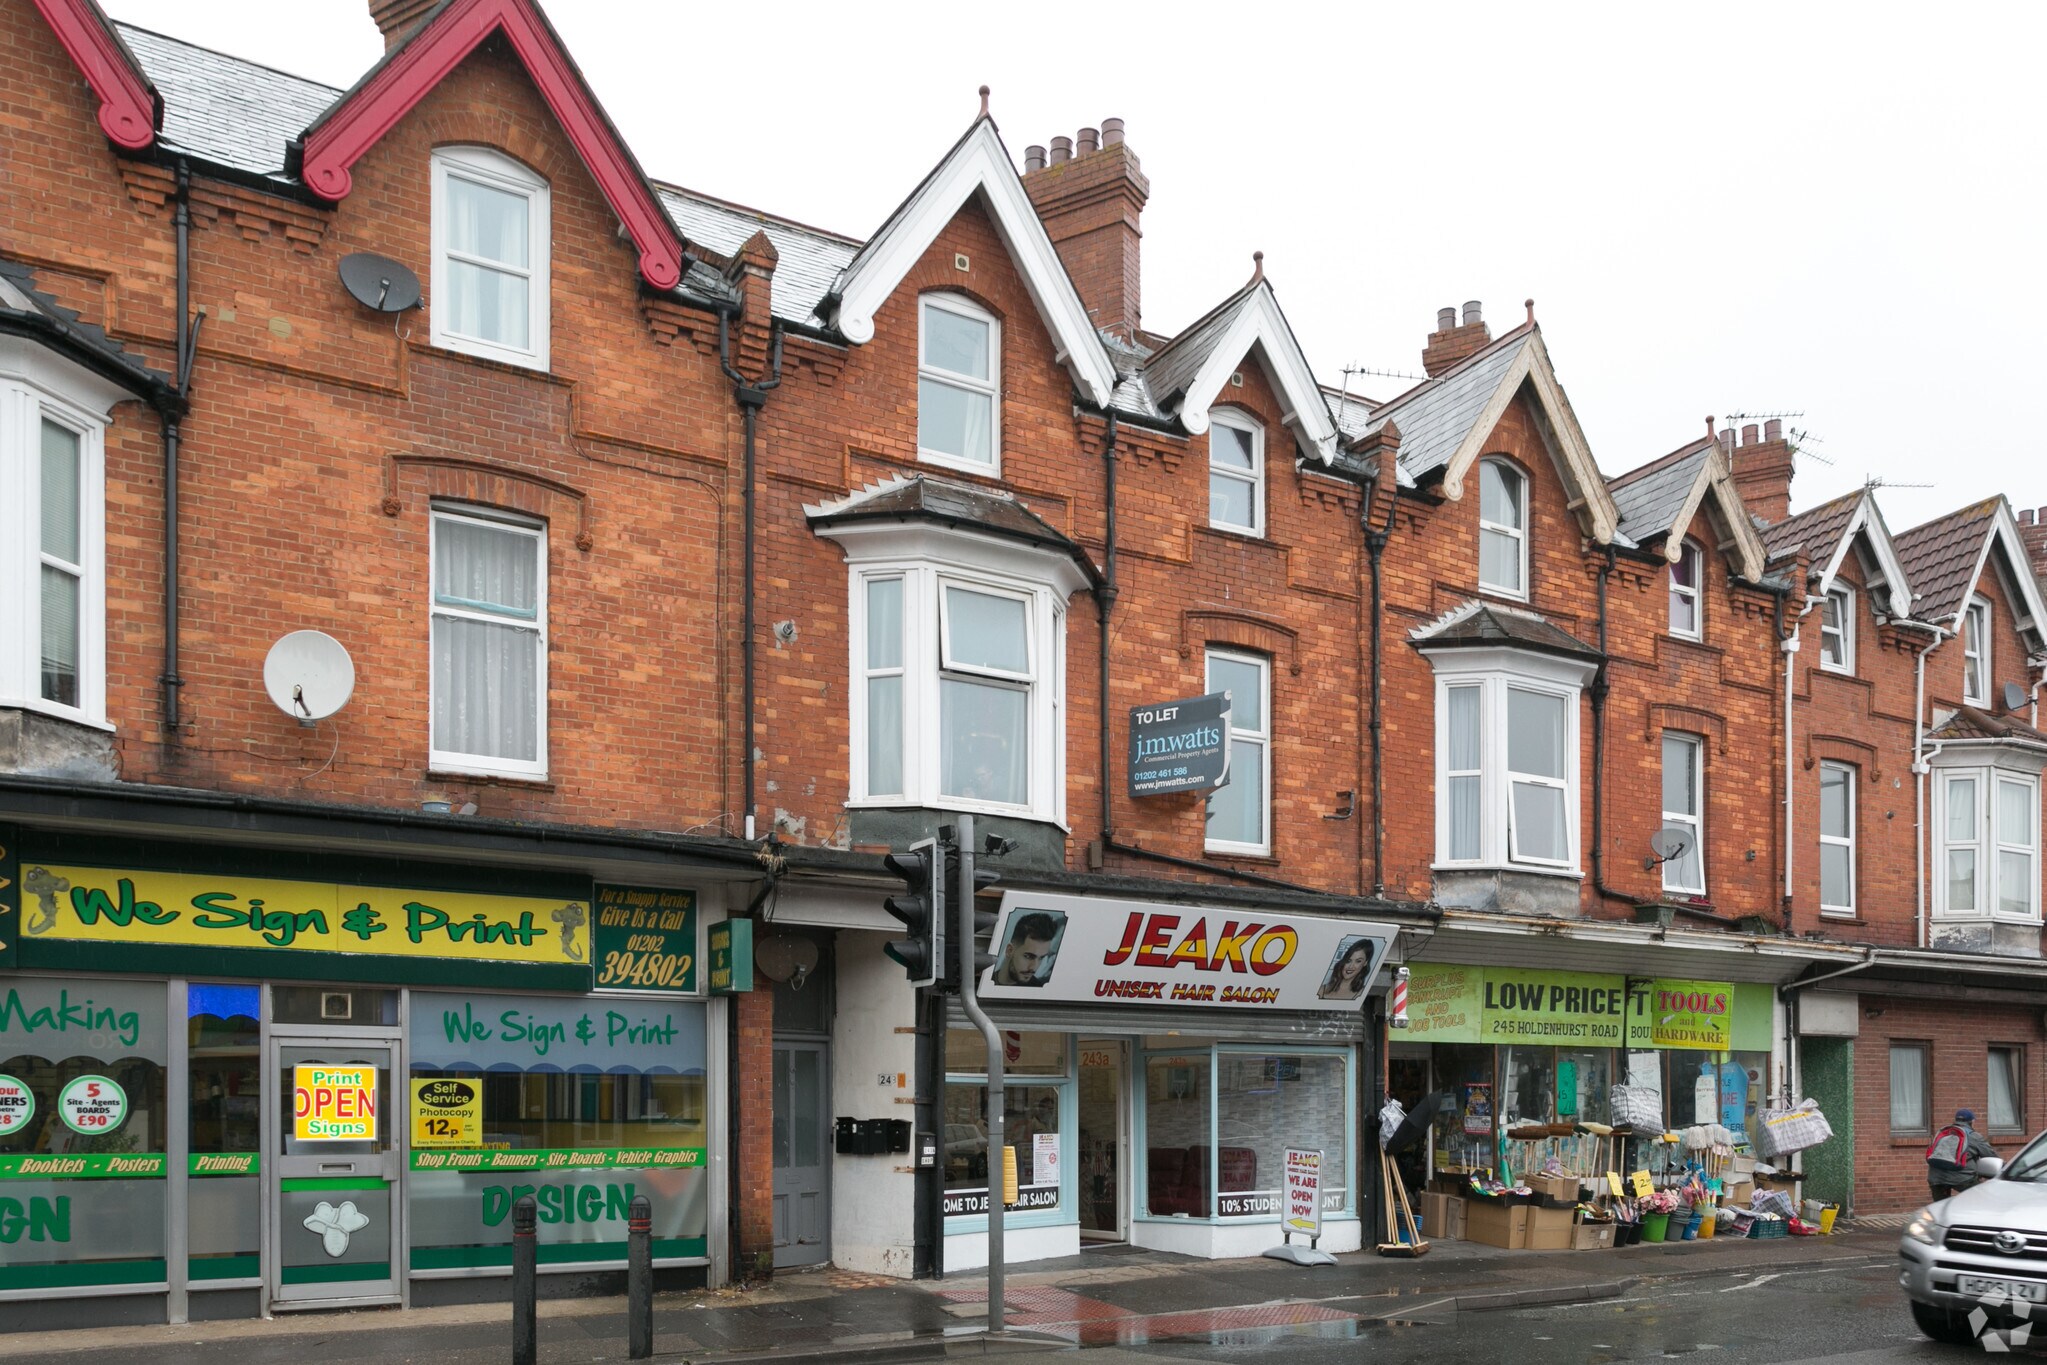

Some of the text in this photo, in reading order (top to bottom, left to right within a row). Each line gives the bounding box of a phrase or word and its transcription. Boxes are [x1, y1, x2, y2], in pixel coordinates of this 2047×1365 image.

[1136, 707, 1179, 724] TO LET
[1144, 747, 1219, 763] Commercial Property Agents
[1134, 770, 1157, 781] 01202
[1158, 768, 1172, 779] 461
[1134, 774, 1205, 790] www.jmwatts.com
[600, 888, 691, 908] For a Snappy Service
[70, 878, 548, 946] We Sign & Print
[600, 906, 686, 931] Give Us a Call
[626, 934, 665, 953] 01202
[1103, 911, 1299, 977] JEAKO
[598, 950, 692, 987] 394802
[712, 968, 731, 988] PRINT
[1410, 971, 1465, 991] SURPLUS
[1094, 979, 1281, 1004] UNISEX HAIR SALON
[1485, 981, 1545, 1012] LOW
[1550, 984, 1622, 1016] PRICE
[1425, 1002, 1449, 1017] AND
[1658, 990, 1727, 1015] TOOLS
[0, 989, 139, 1046] Making
[1408, 1012, 1466, 1034] JOB TOOLS
[1679, 1017, 1696, 1027] and
[443, 1002, 679, 1056] We Sign & Print
[1493, 1020, 1515, 1034] 245
[1517, 1020, 1588, 1036] HOLDENHURST
[1592, 1024, 1619, 1038] ROAD
[1656, 1027, 1724, 1044] HARDWARE
[1082, 1052, 1110, 1066] 243a
[313, 1072, 362, 1084] Print
[87, 1083, 100, 1098] 5
[434, 1082, 458, 1094] Self
[66, 1098, 84, 1106] Site
[92, 1098, 120, 1108] Agents
[296, 1088, 375, 1118] OPEN
[424, 1093, 470, 1104] Service
[77, 1114, 107, 1127] £90
[420, 1108, 474, 1118] Photocopy
[309, 1120, 365, 1137] Signs
[18, 1158, 87, 1174] Booklets
[106, 1156, 162, 1174] Posters
[194, 1155, 252, 1172] Printing
[416, 1152, 446, 1168] Shop
[446, 1152, 484, 1166] Fronts
[491, 1152, 538, 1166] Banners
[546, 1152, 568, 1166] Site
[568, 1152, 607, 1165] Boards
[616, 1151, 652, 1164] Vehicle
[653, 1150, 699, 1164] Graphics
[1287, 1152, 1320, 1168] JEAKO
[1288, 1174, 1317, 1188] WE ARE
[965, 1196, 978, 1211] TO
[1012, 1193, 1029, 1208] AIR
[1030, 1192, 1056, 1206] SALON
[1292, 1190, 1313, 1202] OPEN
[1222, 1198, 1240, 1212] 10%
[1292, 1204, 1312, 1216] NOW
